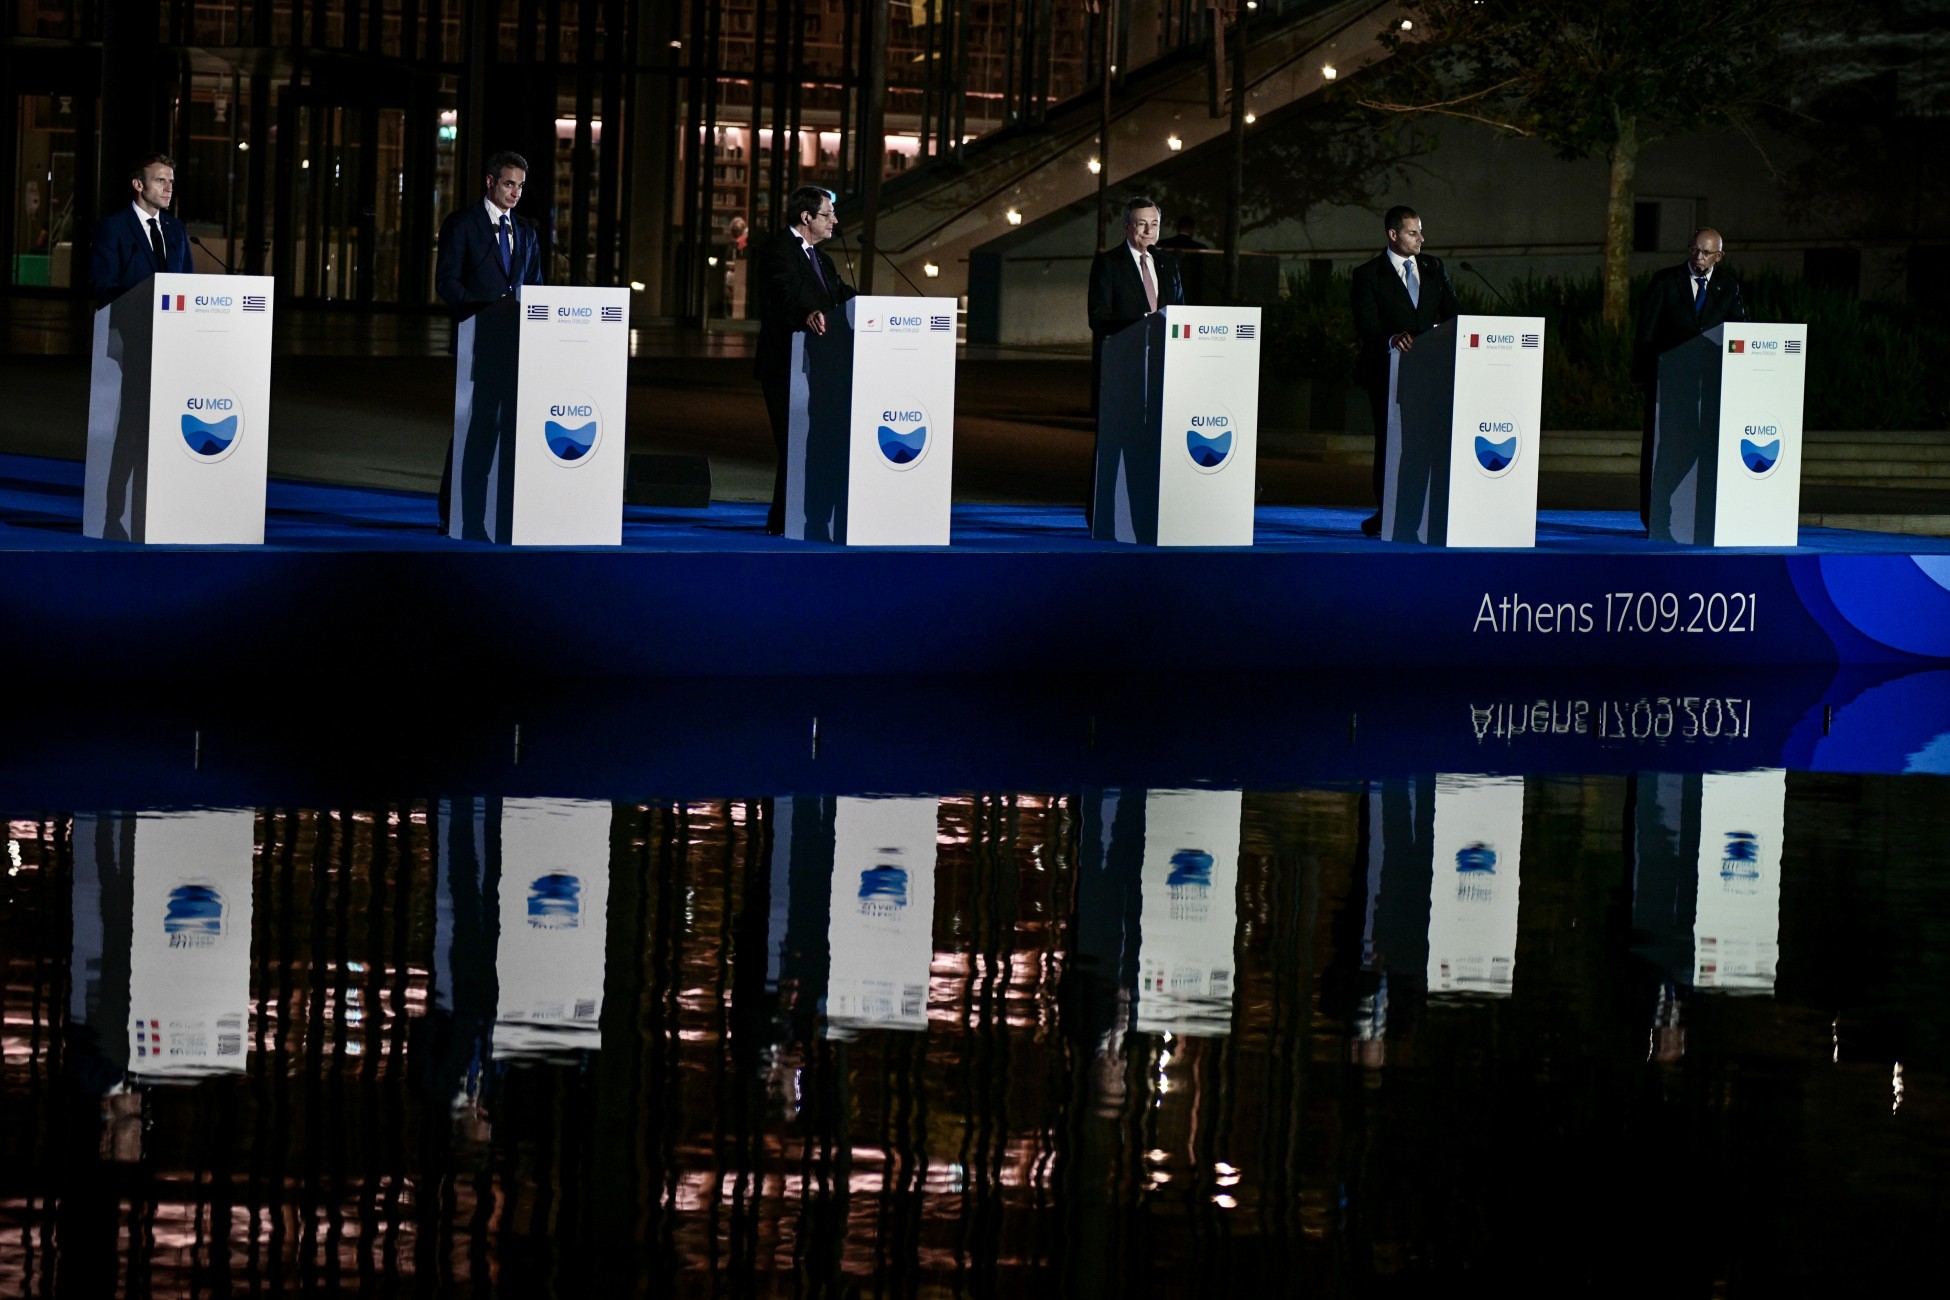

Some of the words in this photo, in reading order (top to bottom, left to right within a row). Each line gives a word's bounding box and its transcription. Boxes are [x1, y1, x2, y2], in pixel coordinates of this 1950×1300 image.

[195, 295, 209, 306] EU
[210, 296, 233, 306] MED
[557, 307, 571, 317] EU
[572, 307, 593, 317] MED
[889, 316, 902, 326] EU
[902, 317, 922, 326] MED
[1198, 325, 1210, 334] EU
[1210, 325, 1229, 335] MED
[1486, 334, 1497, 343] EU
[1497, 335, 1515, 344] MED
[1751, 341, 1761, 349] EU
[1762, 341, 1778, 350] MED
[187, 397, 203, 410] EU
[205, 398, 233, 411] MED
[550, 405, 565, 416] EU
[567, 405, 593, 417] MED
[882, 410, 898, 421] EU
[899, 411, 923, 422] MED
[1191, 416, 1205, 427] EU
[1206, 416, 1229, 427] MED
[1479, 422, 1491, 433] EU
[1492, 422, 1514, 433] MED
[1744, 425, 1757, 435] EU
[1757, 425, 1777, 436] MED
[1473, 593, 1594, 633] Athens
[1605, 592, 1756, 633] 17.09.2021
